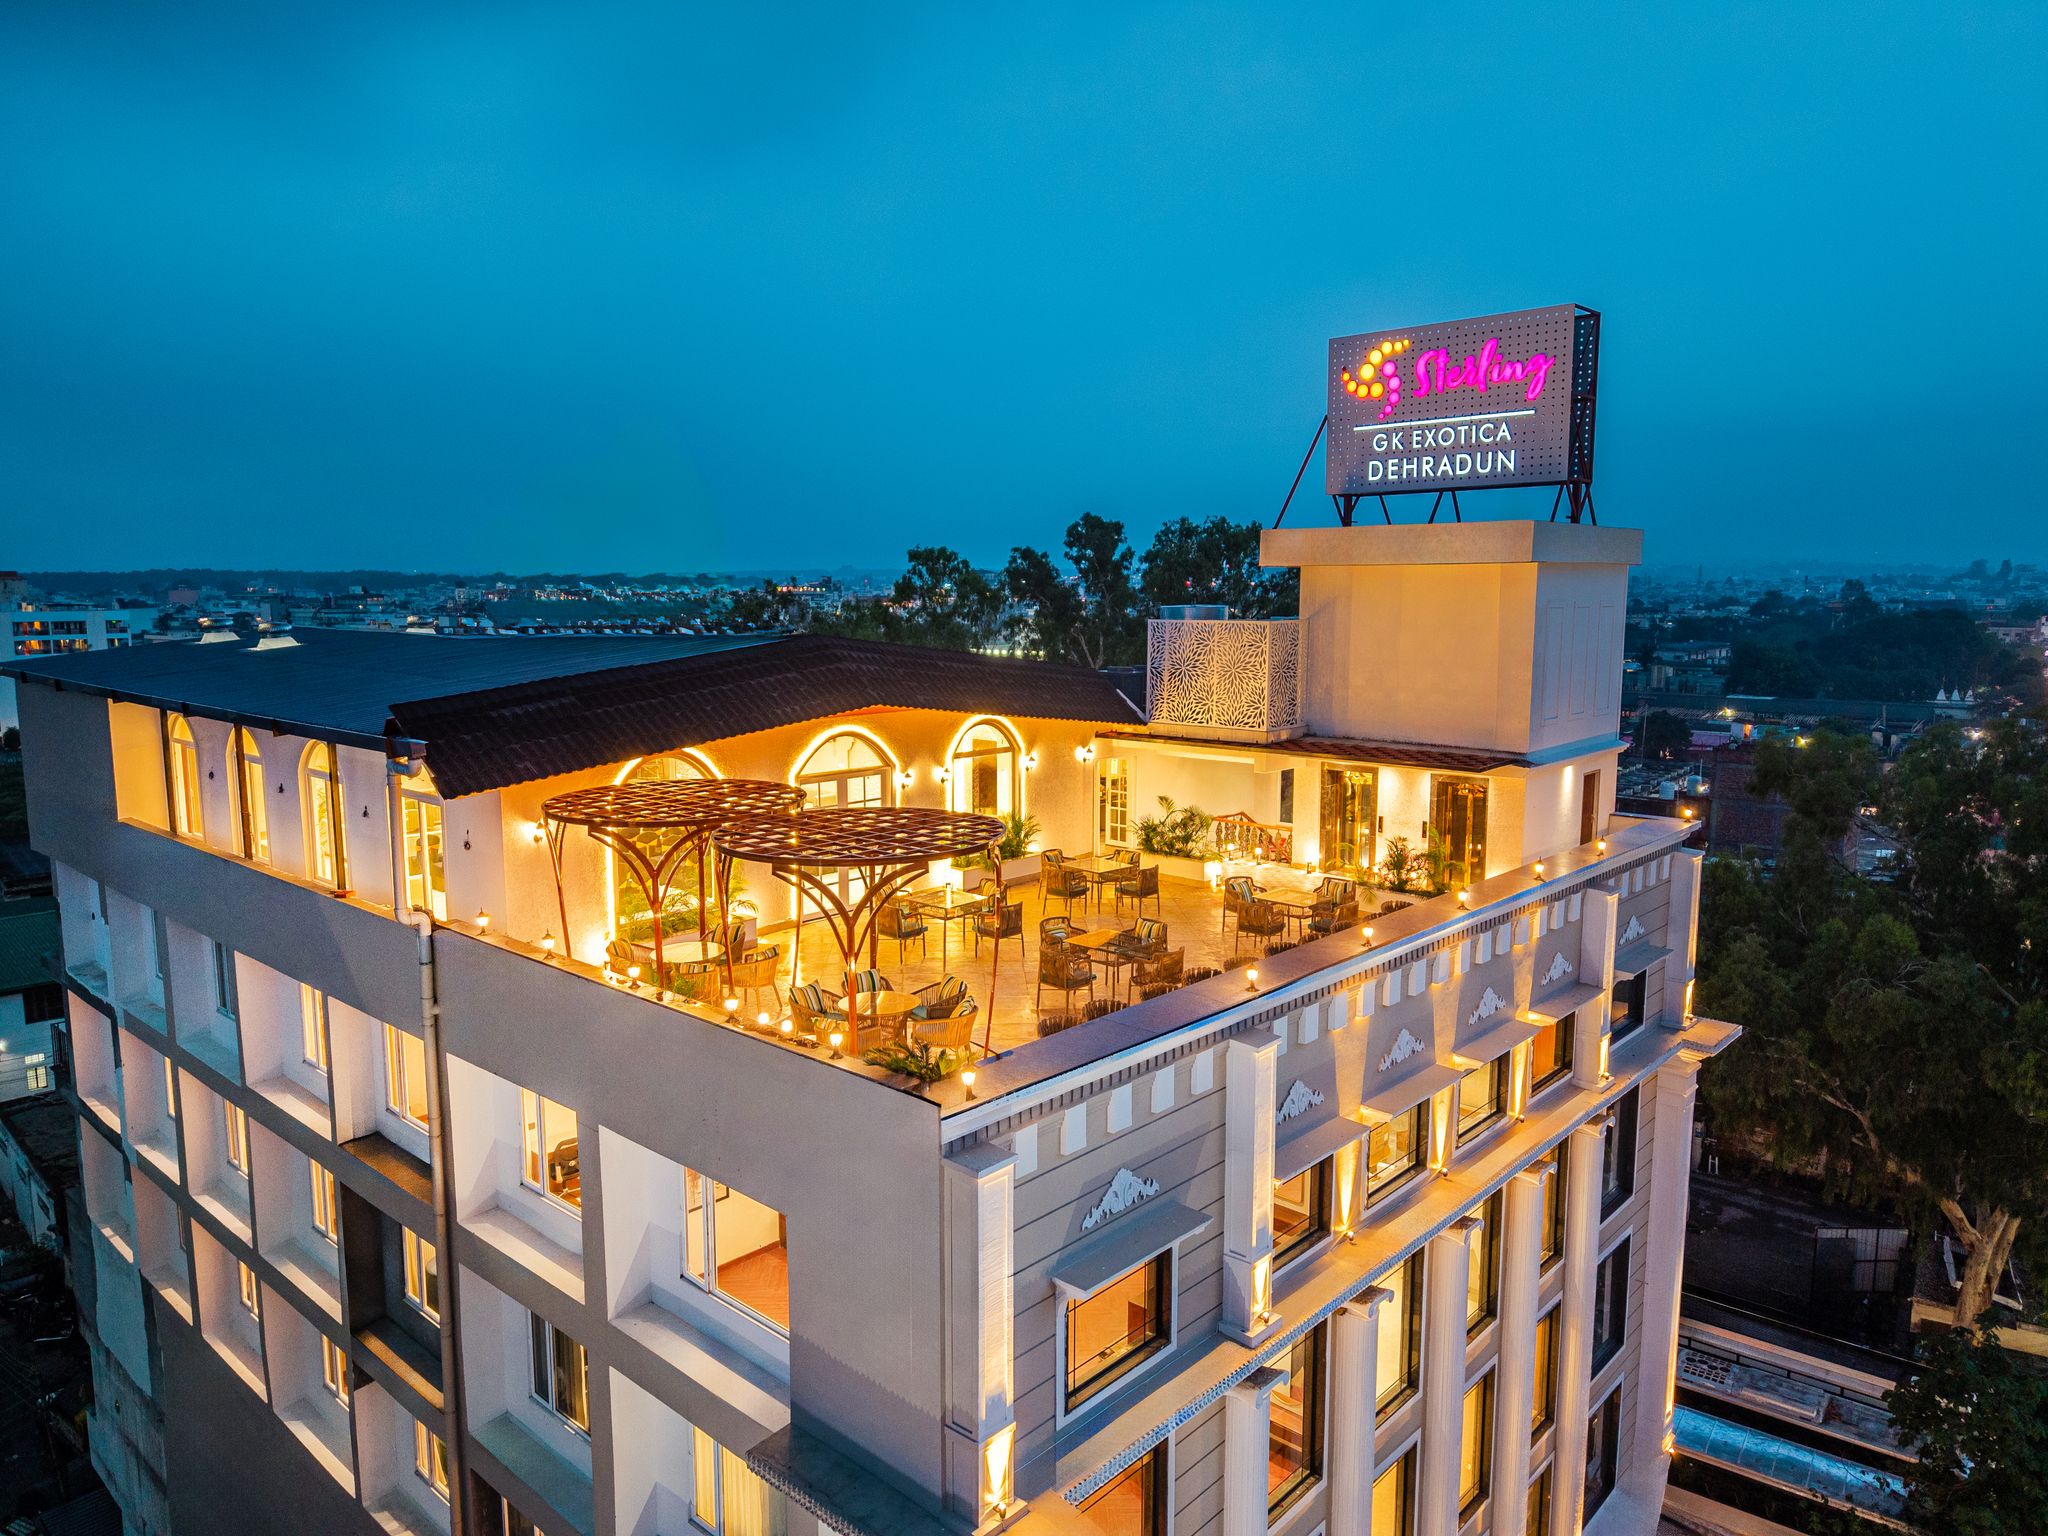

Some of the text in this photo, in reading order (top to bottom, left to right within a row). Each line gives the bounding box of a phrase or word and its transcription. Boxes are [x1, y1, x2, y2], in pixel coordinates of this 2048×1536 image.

[1413, 338, 1555, 400] Sterling
[1373, 422, 1511, 451] GK EXOTICA
[1368, 450, 1515, 481] DEHRADUN
